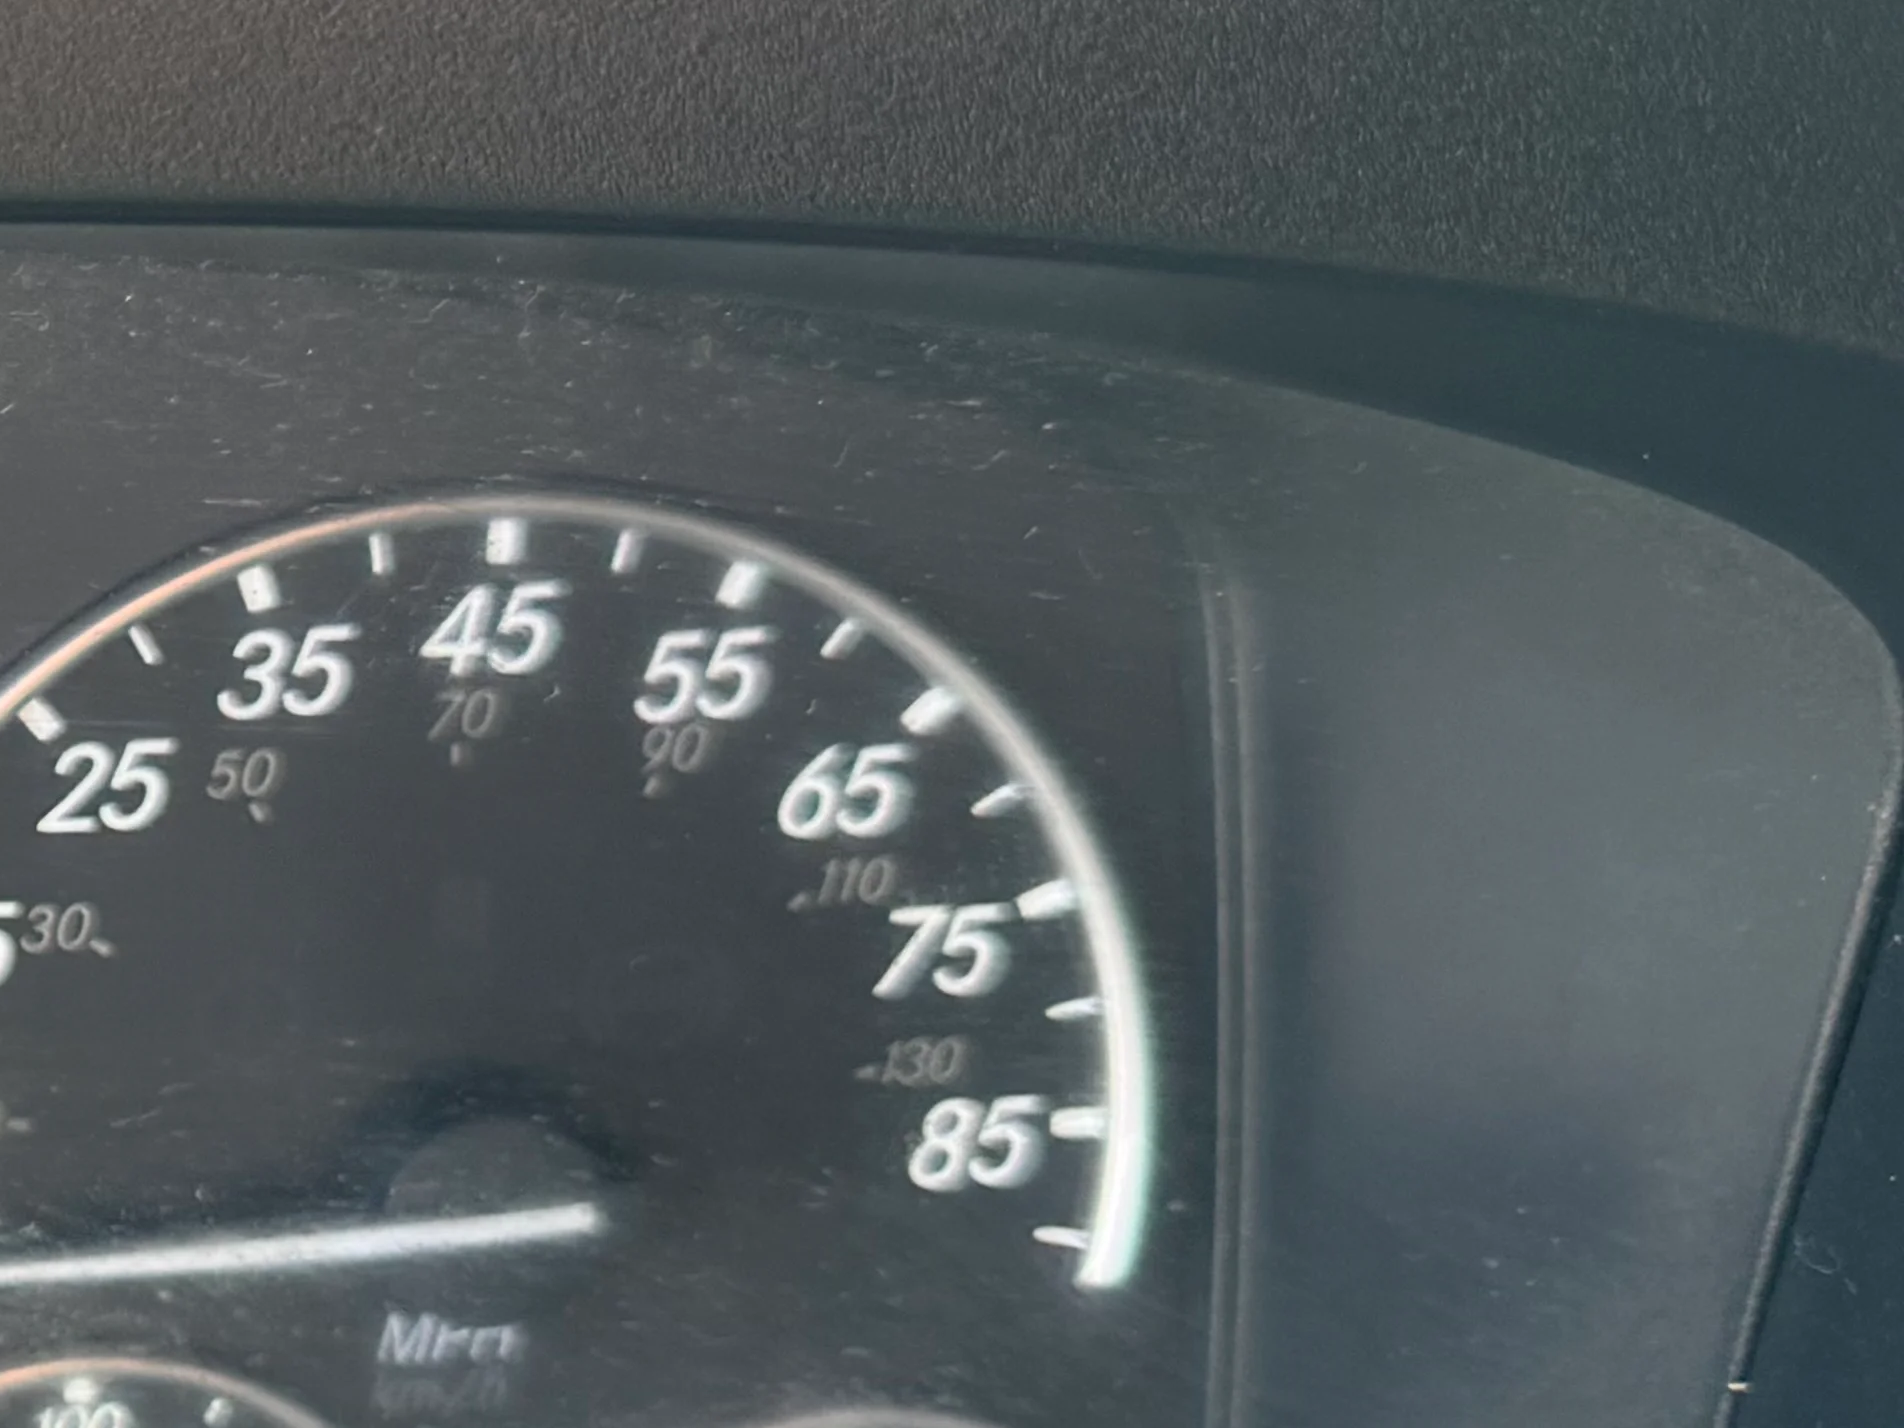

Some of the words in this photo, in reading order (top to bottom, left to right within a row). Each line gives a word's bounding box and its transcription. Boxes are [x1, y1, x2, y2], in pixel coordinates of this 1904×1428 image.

[217, 622, 360, 722] 35
[420, 577, 574, 677] 45
[633, 623, 780, 726] 55
[425, 687, 508, 743] 70
[642, 721, 714, 776] 90
[36, 736, 180, 835] 25
[205, 747, 283, 803] 50
[776, 740, 920, 842] 65
[20, 902, 95, 958] 30
[873, 900, 1014, 1000] 75
[908, 1095, 1048, 1194] 85
